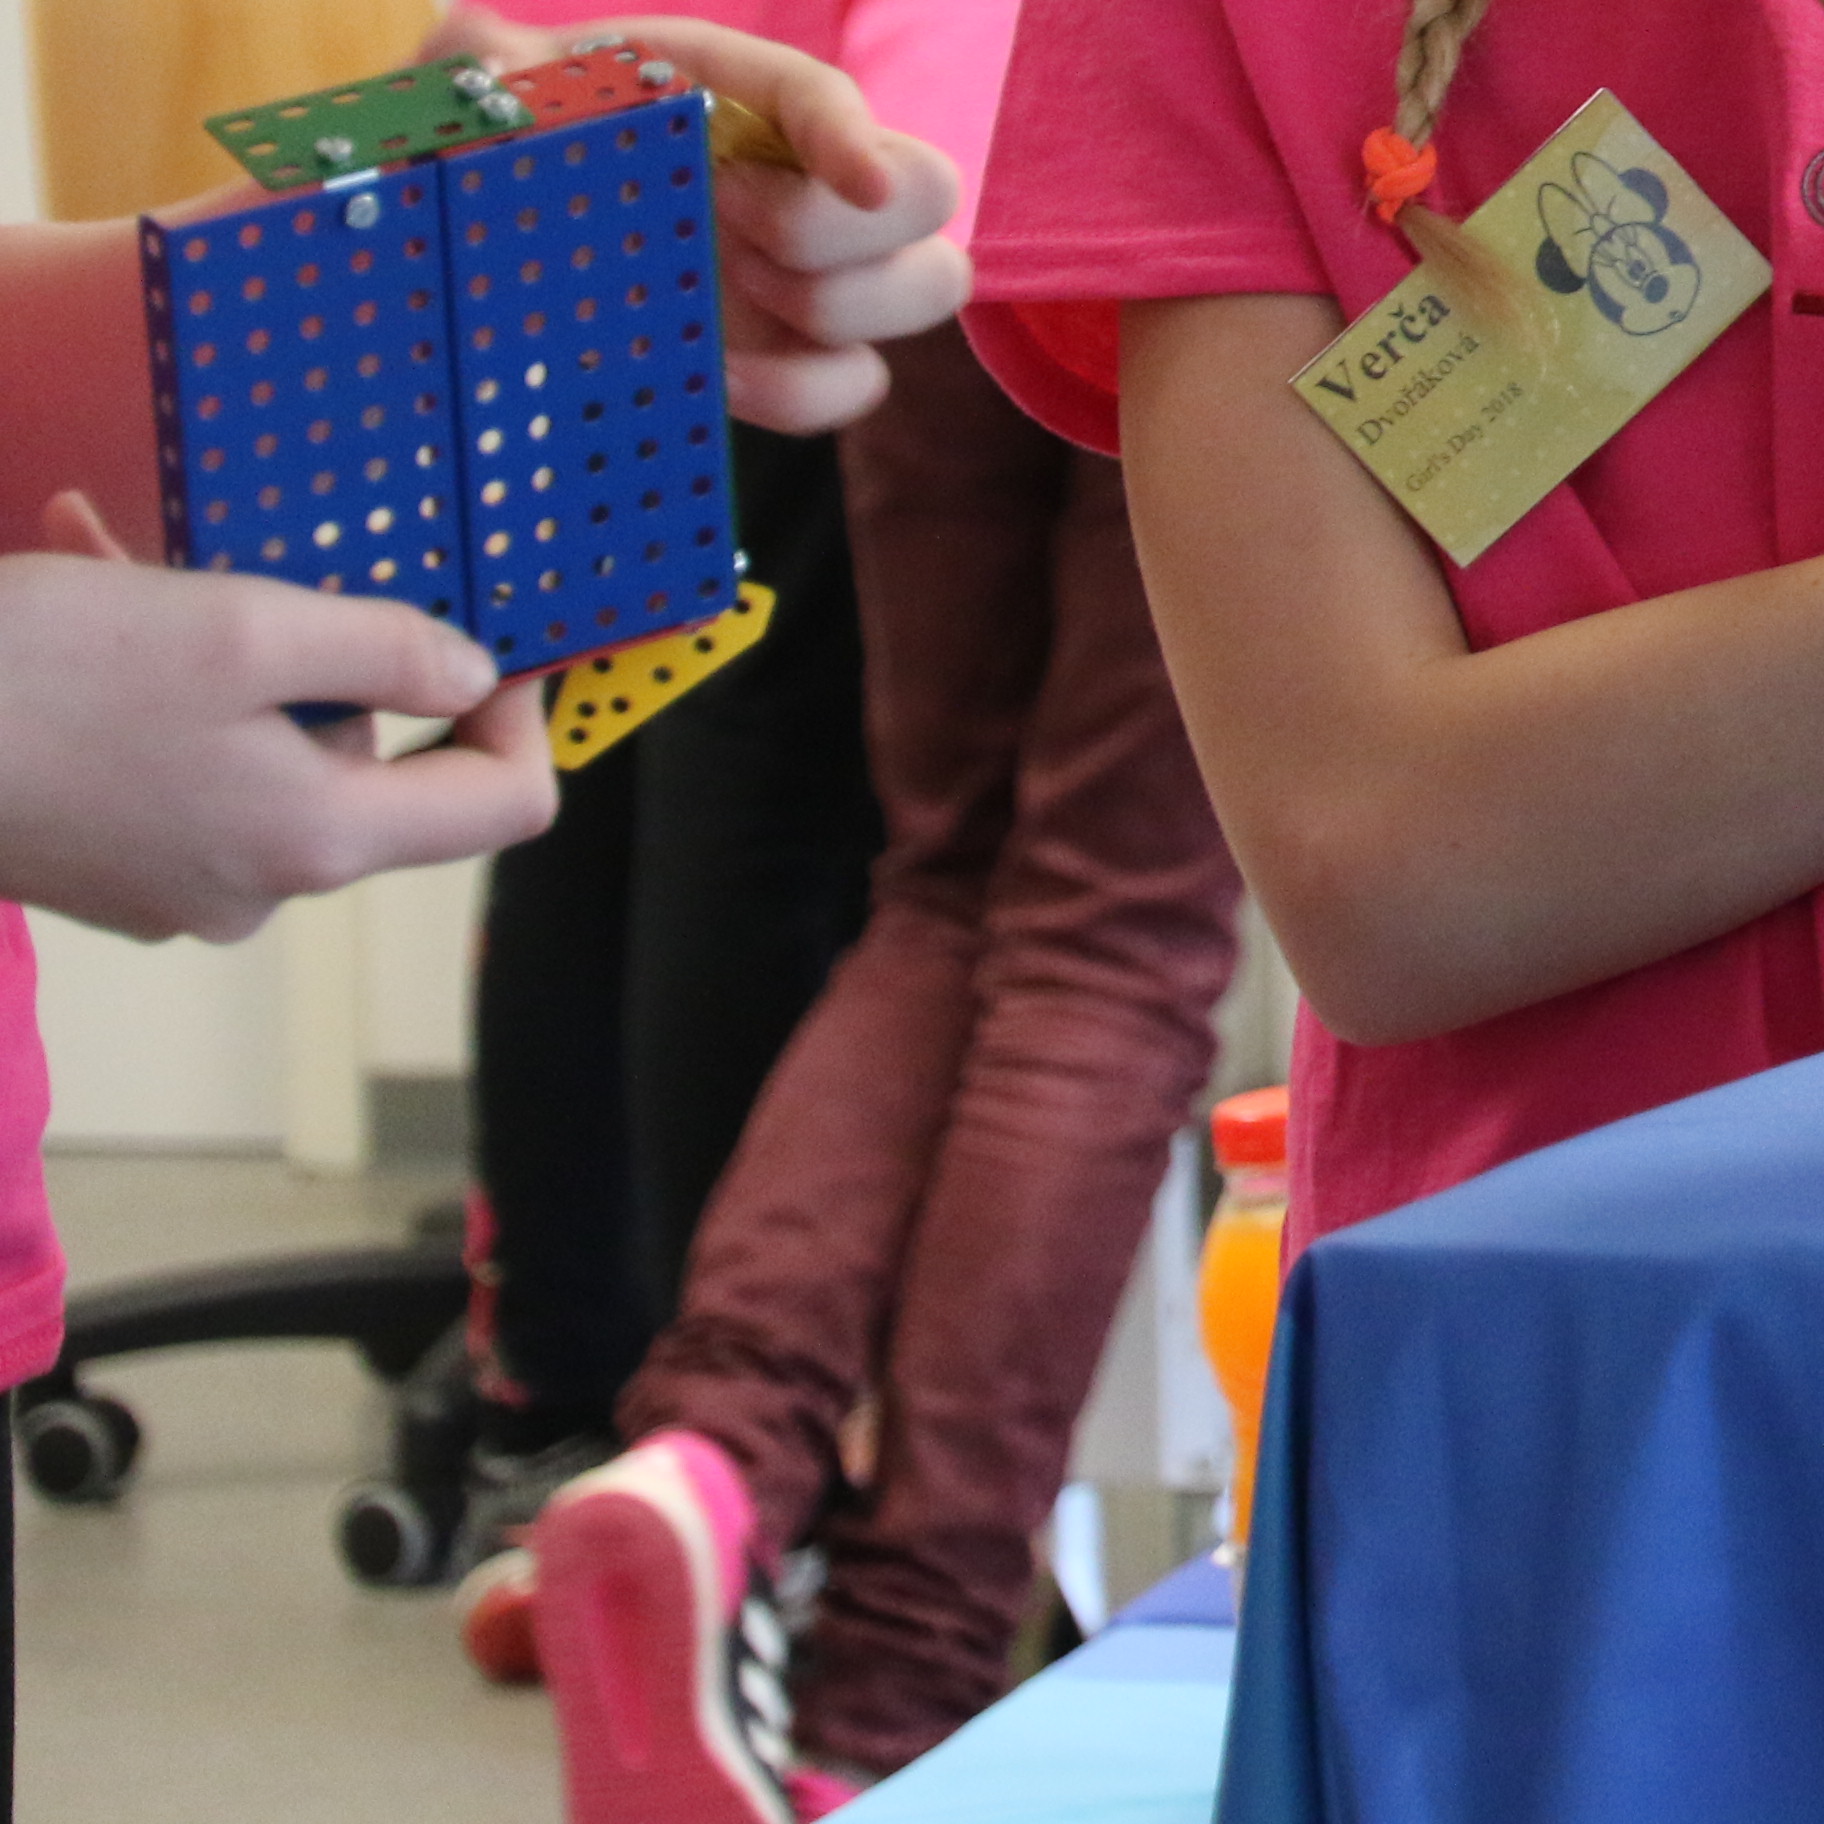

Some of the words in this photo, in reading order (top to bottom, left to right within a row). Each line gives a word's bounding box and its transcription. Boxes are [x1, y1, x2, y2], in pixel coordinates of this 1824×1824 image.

[1315, 293, 1451, 403] Verča
[1354, 330, 1481, 446] Dvořáková
[1446, 424, 1485, 455] Day
[1480, 381, 1524, 424] 2018
